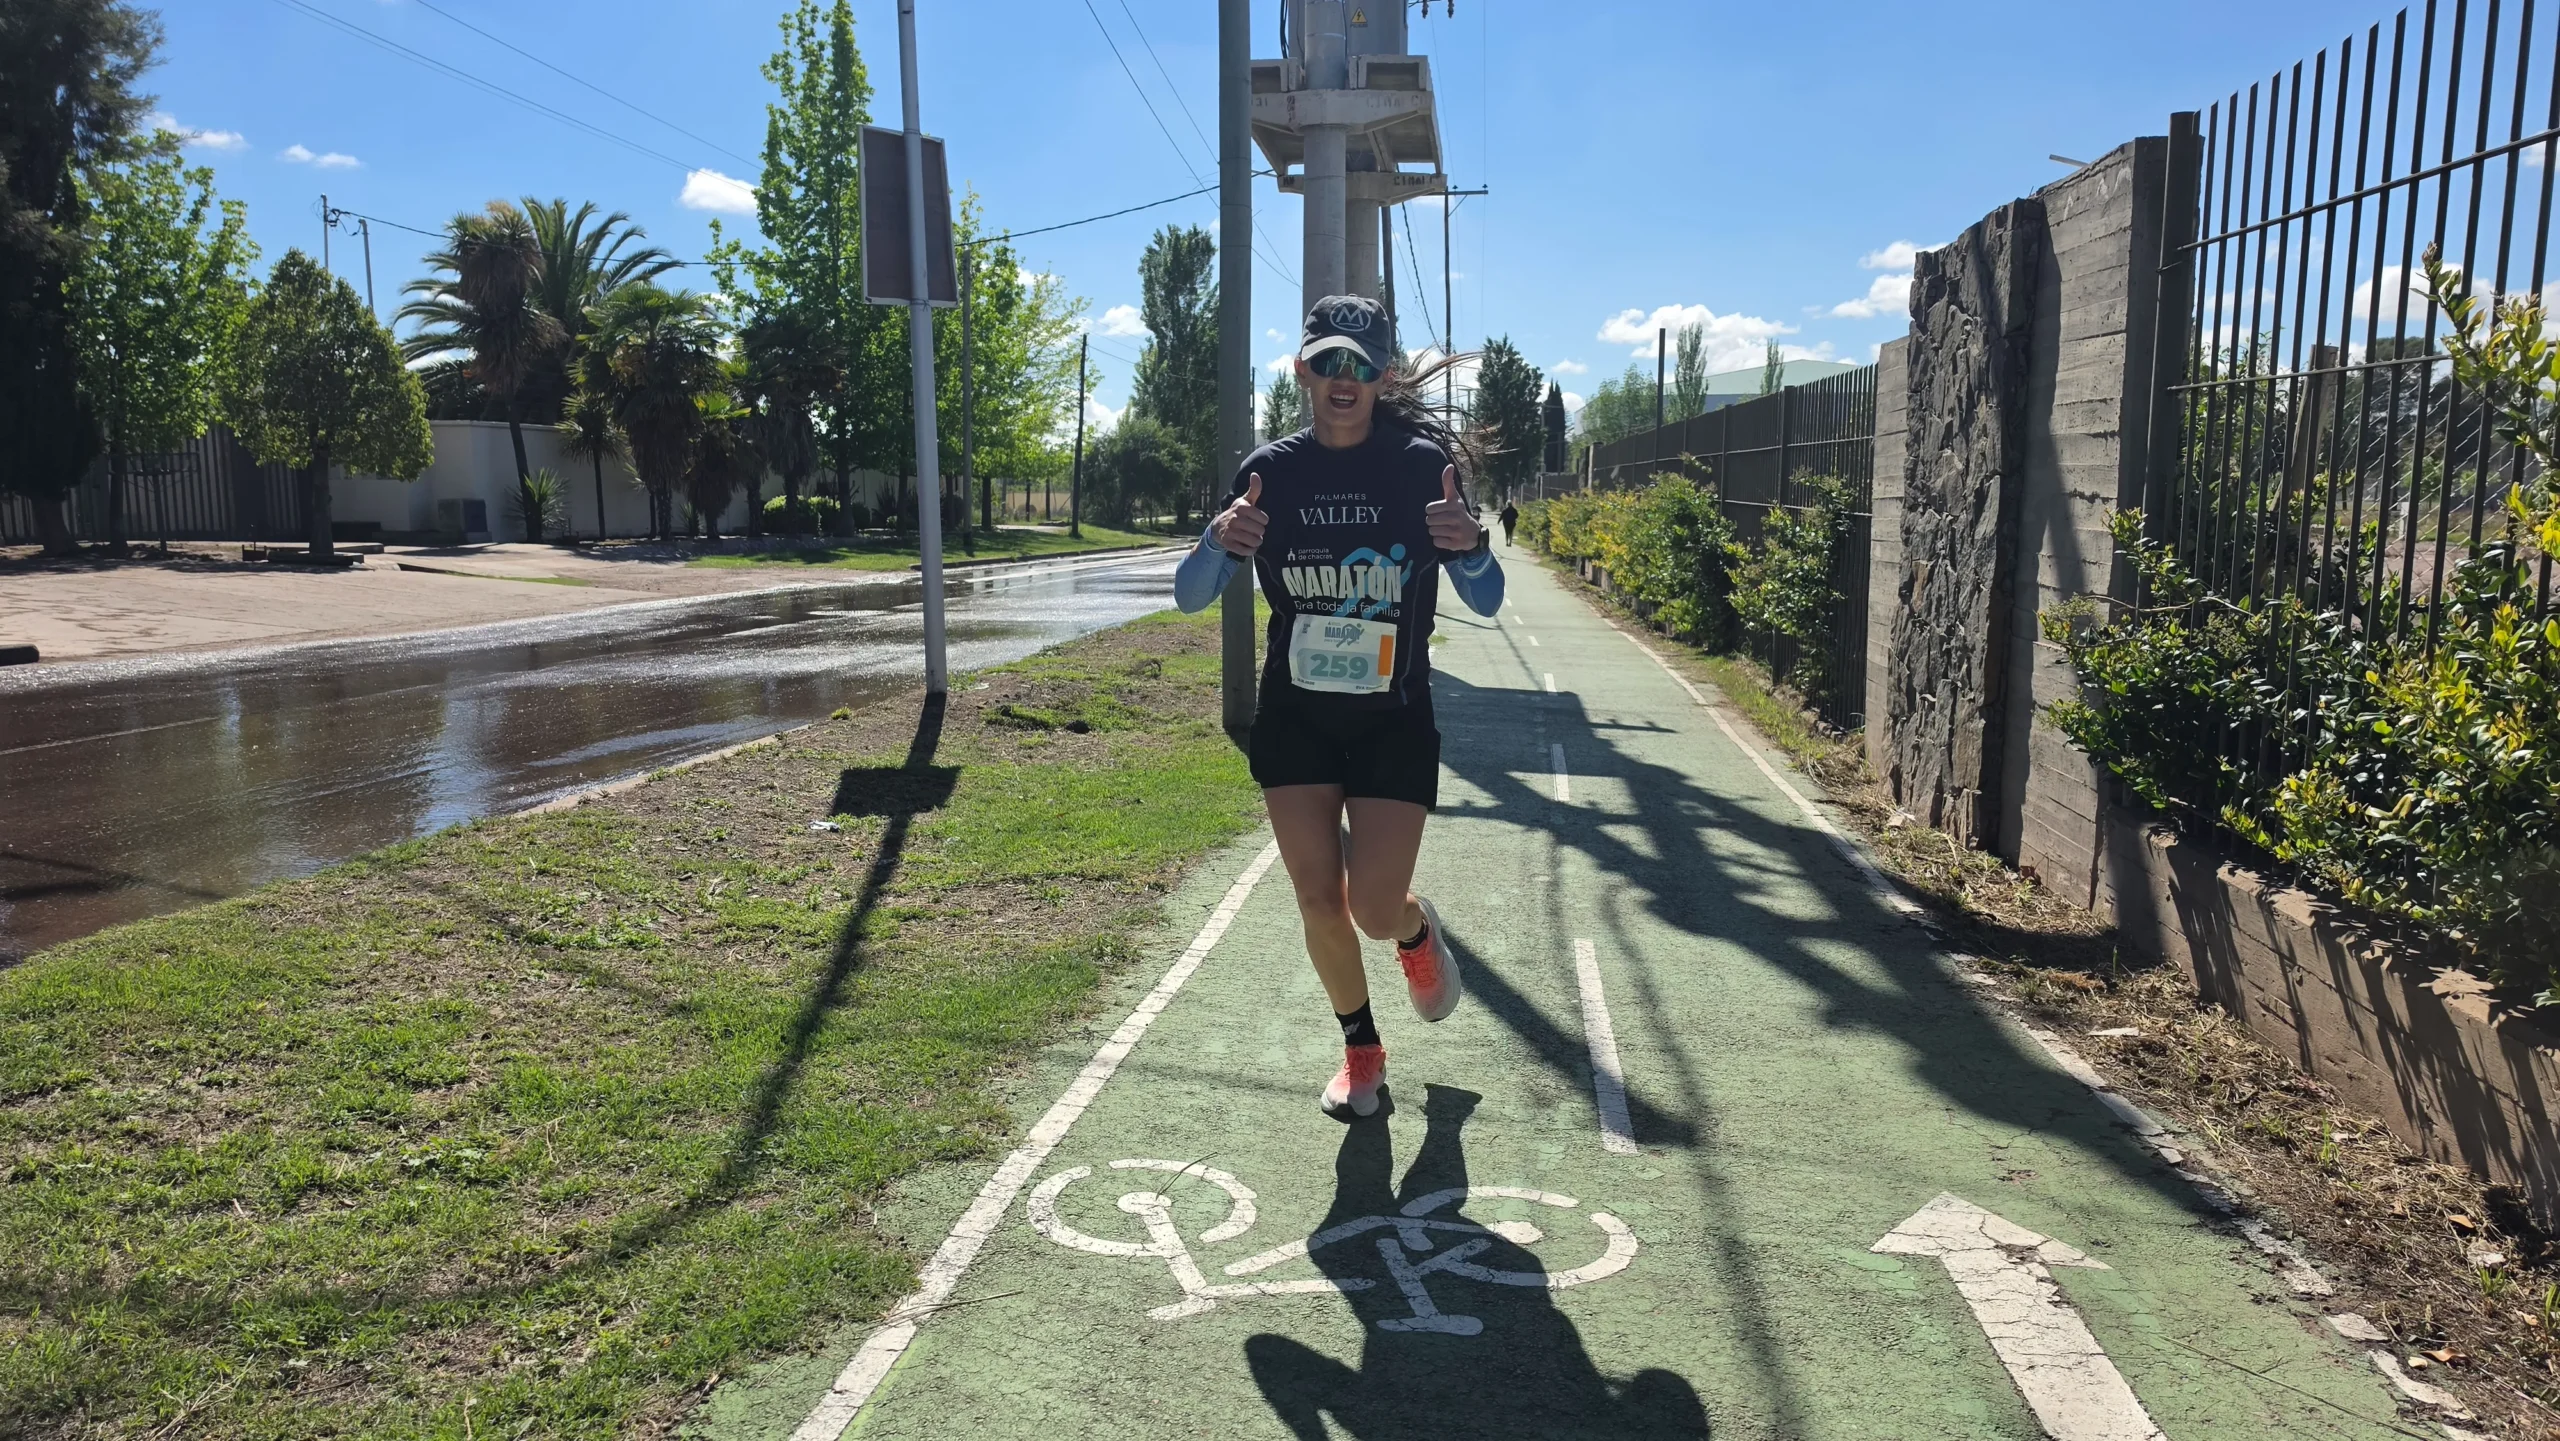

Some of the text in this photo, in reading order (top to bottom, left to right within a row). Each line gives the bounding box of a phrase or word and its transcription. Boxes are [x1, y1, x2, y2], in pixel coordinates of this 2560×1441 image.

[1314, 493, 1367, 502] PALMARES
[1299, 506, 1384, 526] VALLEY
[1282, 555, 1402, 603] MARATÓN
[1316, 600, 1343, 612] toda
[1347, 602, 1357, 613] la
[1360, 602, 1400, 618] familia
[1310, 653, 1369, 680] 259
